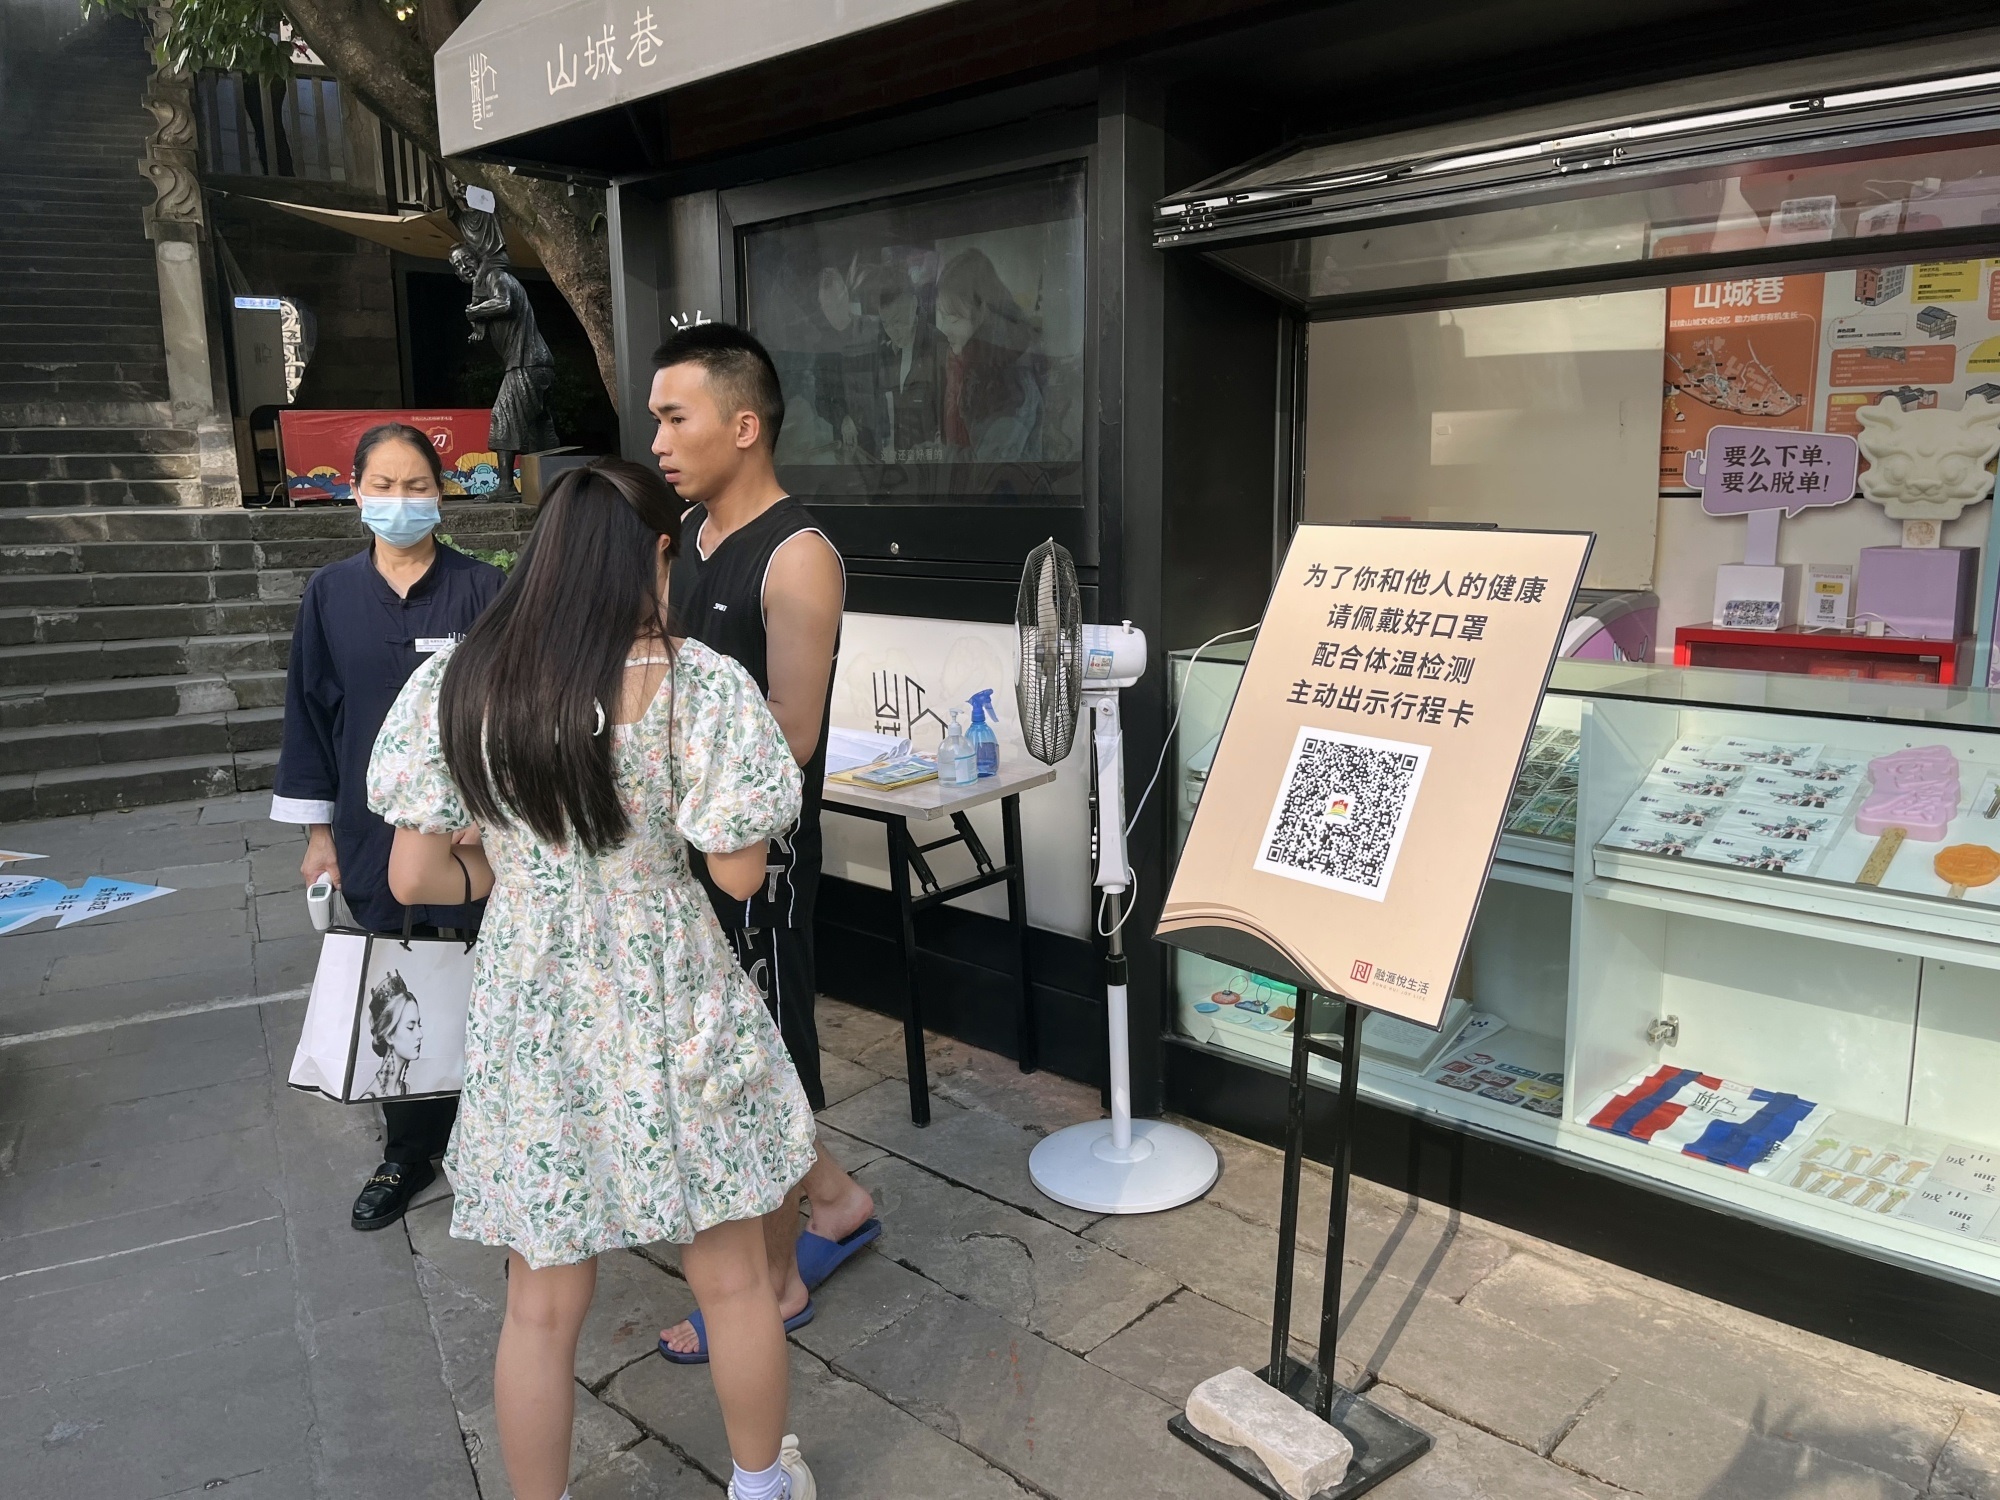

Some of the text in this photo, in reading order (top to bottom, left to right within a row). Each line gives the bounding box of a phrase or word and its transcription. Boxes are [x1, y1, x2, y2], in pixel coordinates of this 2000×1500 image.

[547, 6, 663, 95] 山城巷
[1693, 277, 1785, 309] 山城巷
[1722, 445, 1831, 468] 要么下单，
[1720, 471, 1830, 494] 要么脱单！
[1302, 563, 1549, 604] 为了你和他人的健康
[1326, 603, 1489, 642] 请佩戴好口罩
[1311, 641, 1476, 685] 配合体温检测
[1286, 678, 1475, 728] 主动出示行程卡
